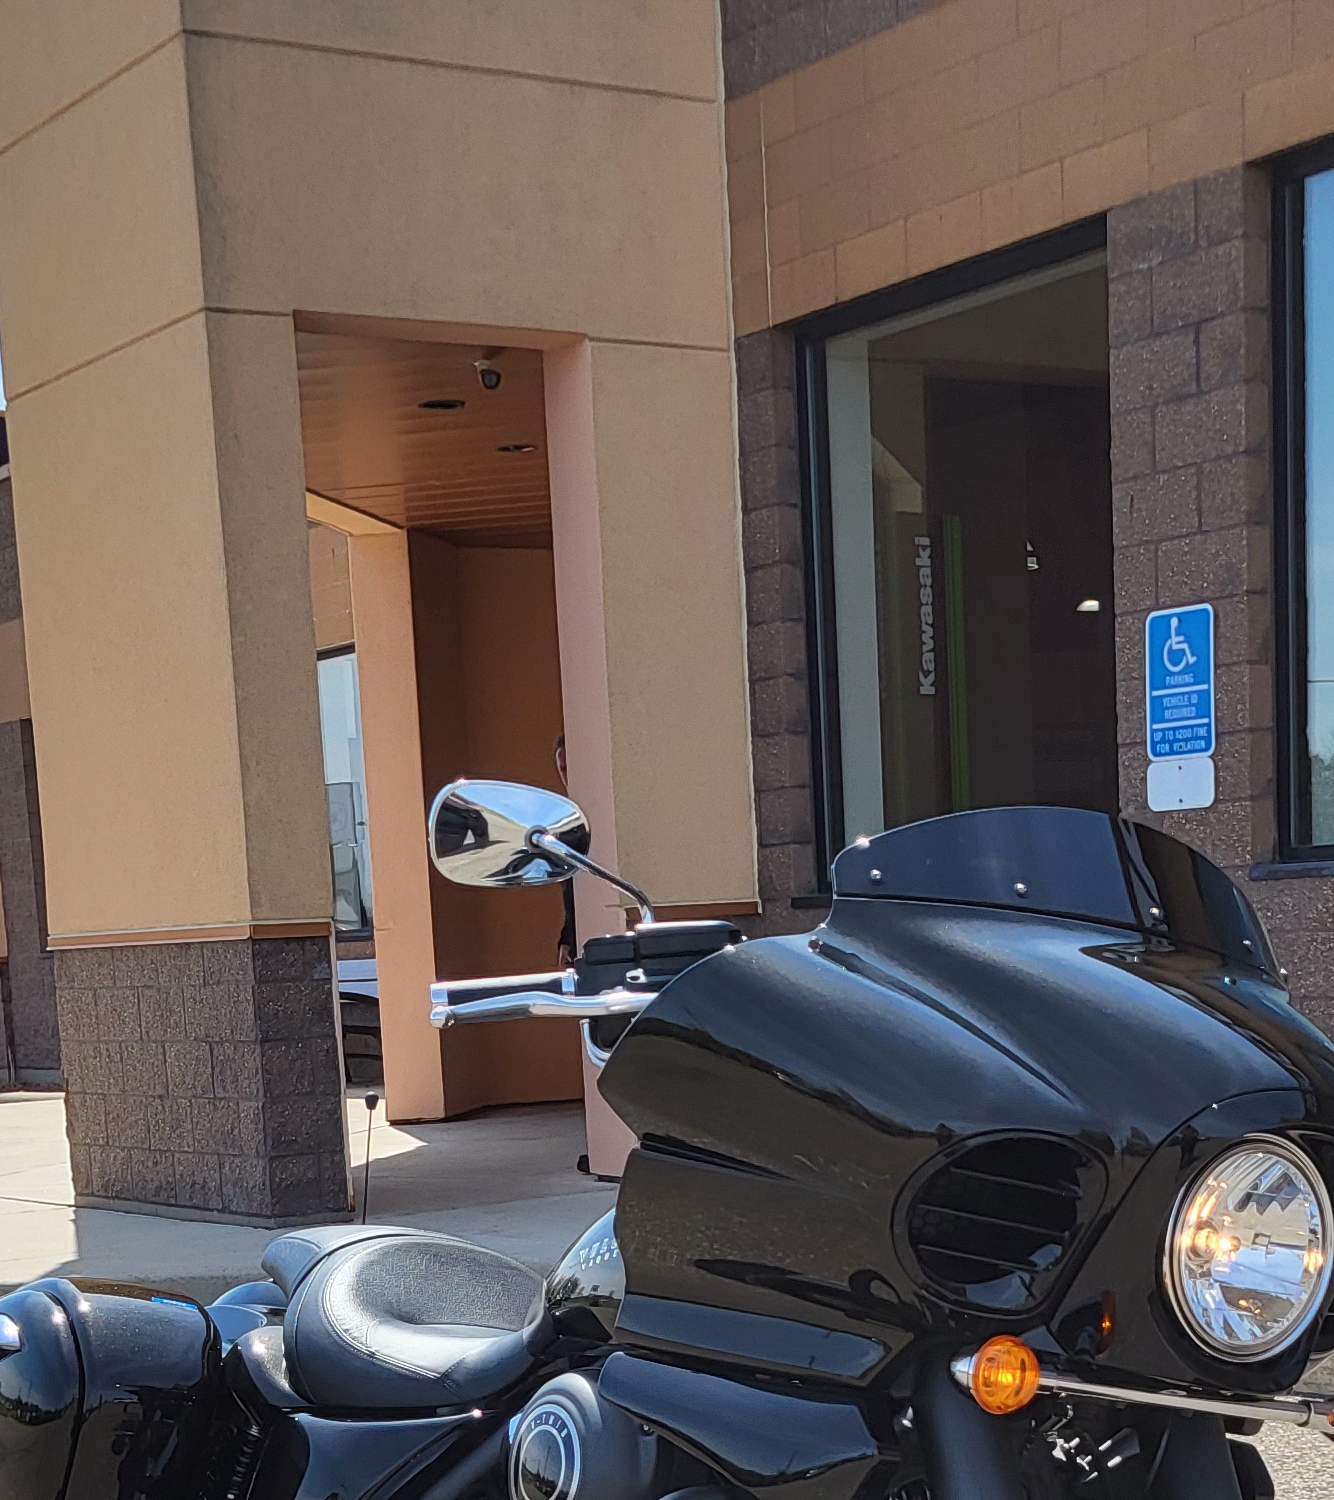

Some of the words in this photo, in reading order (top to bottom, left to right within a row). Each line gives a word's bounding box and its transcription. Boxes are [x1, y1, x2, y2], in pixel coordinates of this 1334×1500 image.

[914, 536, 936, 695] Kawasaki
[1165, 673, 1194, 686] PARKING
[1162, 695, 1189, 708] VEHICLE
[1190, 693, 1198, 704] ID
[1164, 707, 1196, 719] REQUIRED
[1153, 731, 1163, 742] UP
[1165, 730, 1174, 740] TO
[1175, 728, 1192, 739] $200
[1193, 726, 1208, 737] FINE
[1156, 743, 1170, 754] FOR
[1173, 740, 1206, 752] VIOLATION
